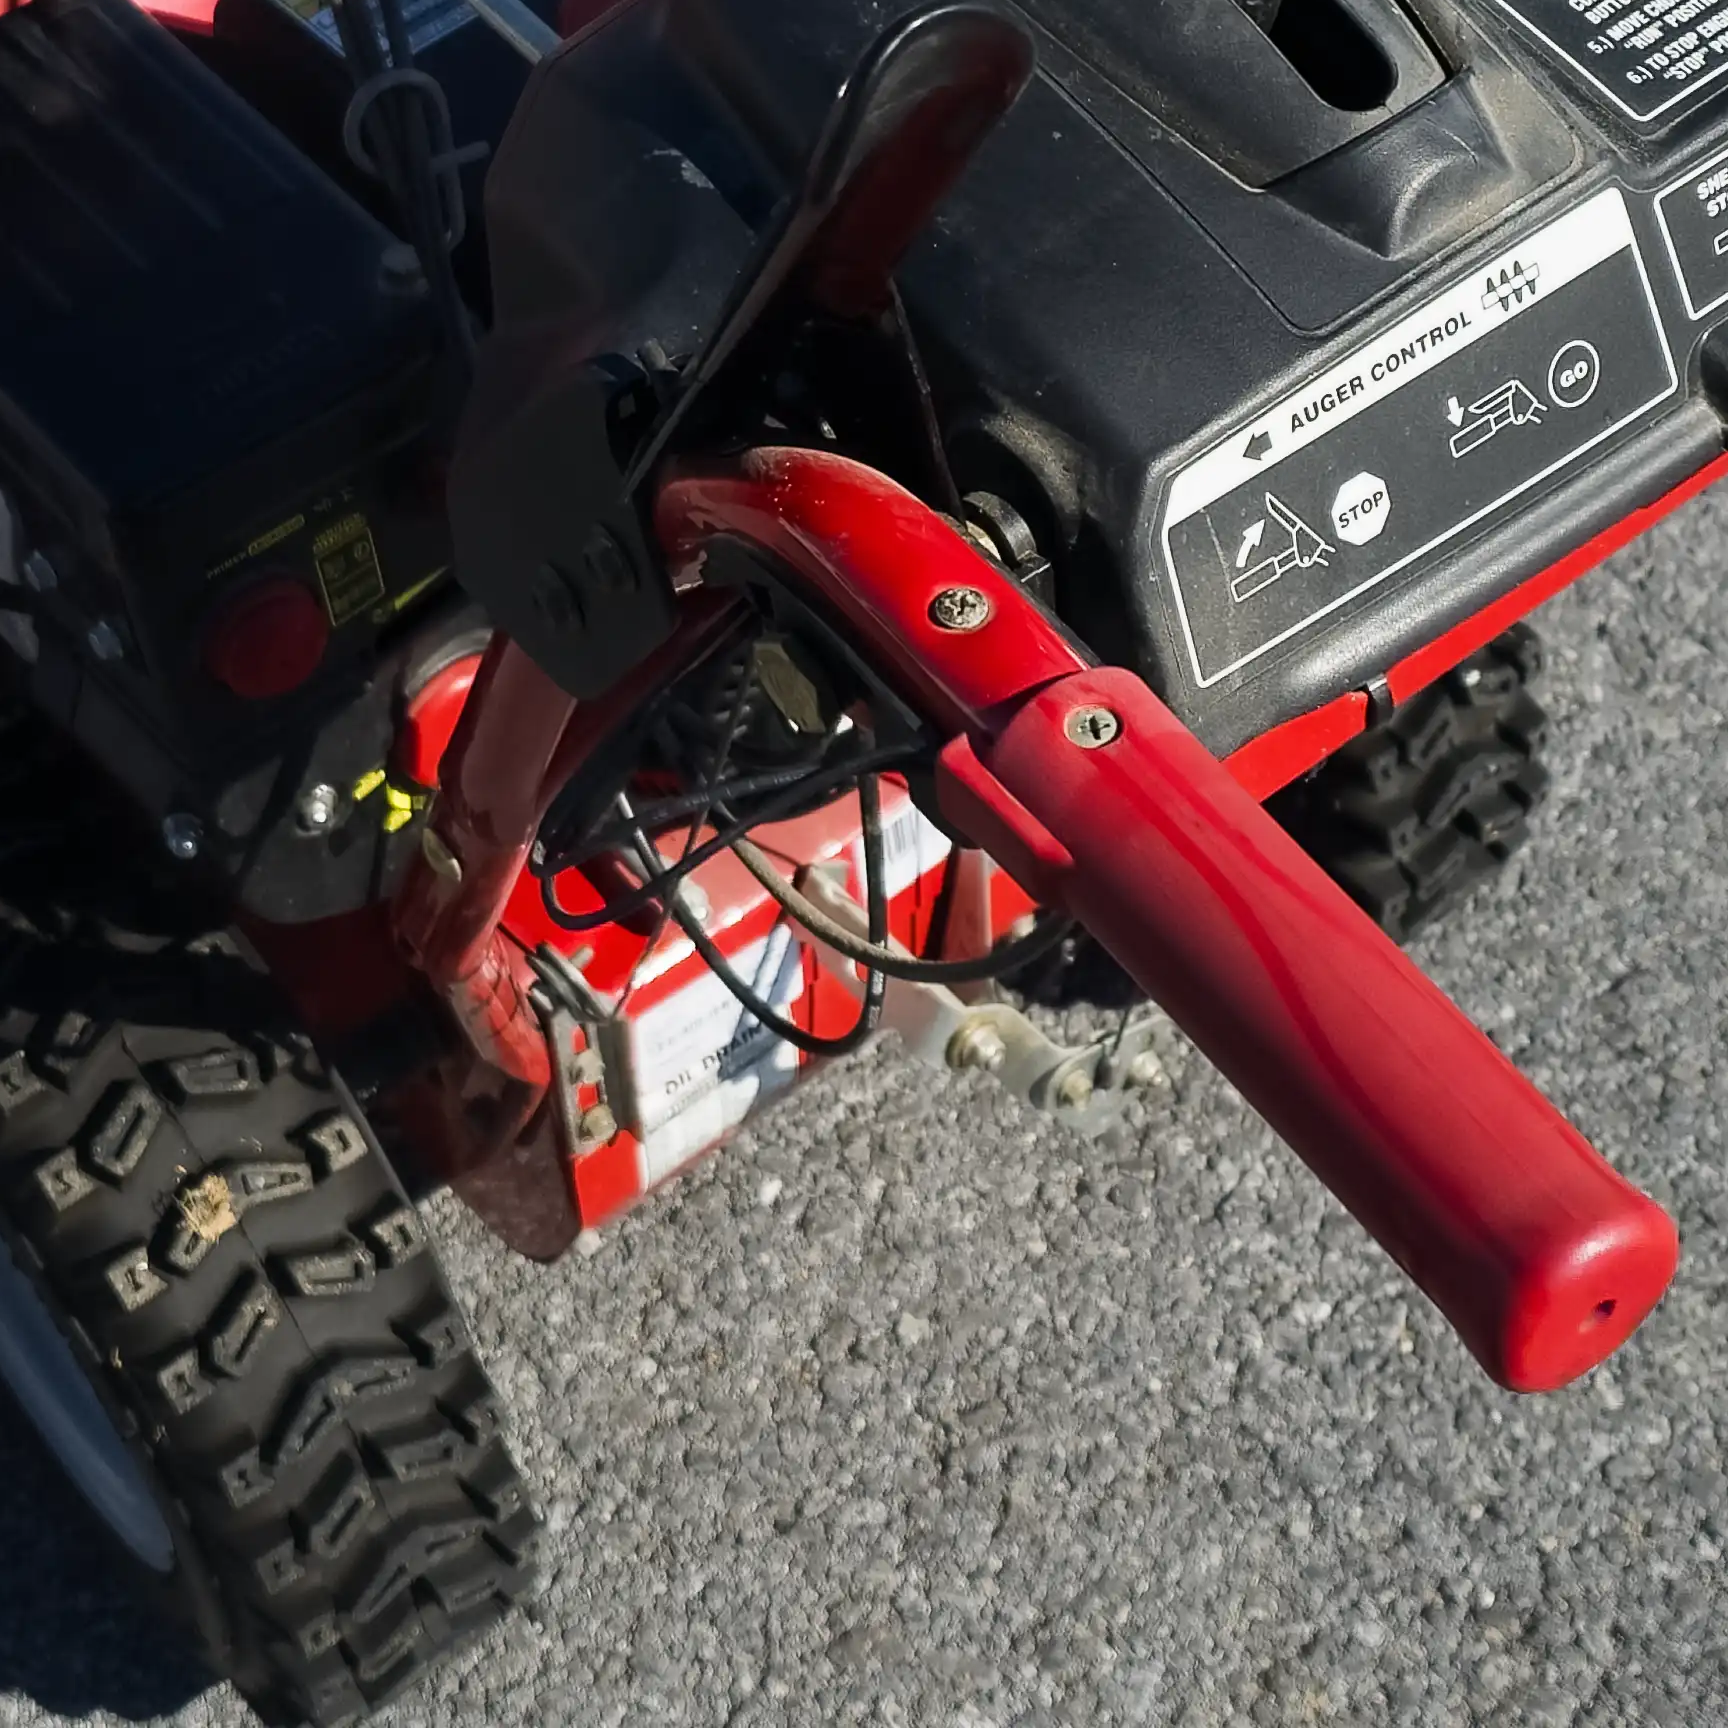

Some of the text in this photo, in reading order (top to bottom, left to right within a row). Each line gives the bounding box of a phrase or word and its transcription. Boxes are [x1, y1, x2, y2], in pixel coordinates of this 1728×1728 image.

[1586, 35, 1614, 53] 5.)
[1605, 10, 1650, 41] MOVE
[1626, 65, 1654, 83] 6.)
[1644, 52, 1669, 70] TO
[1663, 31, 1699, 58] STOP
[1291, 311, 1471, 433] AUGER CONTROL
[1560, 360, 1588, 387] GO
[1338, 491, 1383, 528] STOP
